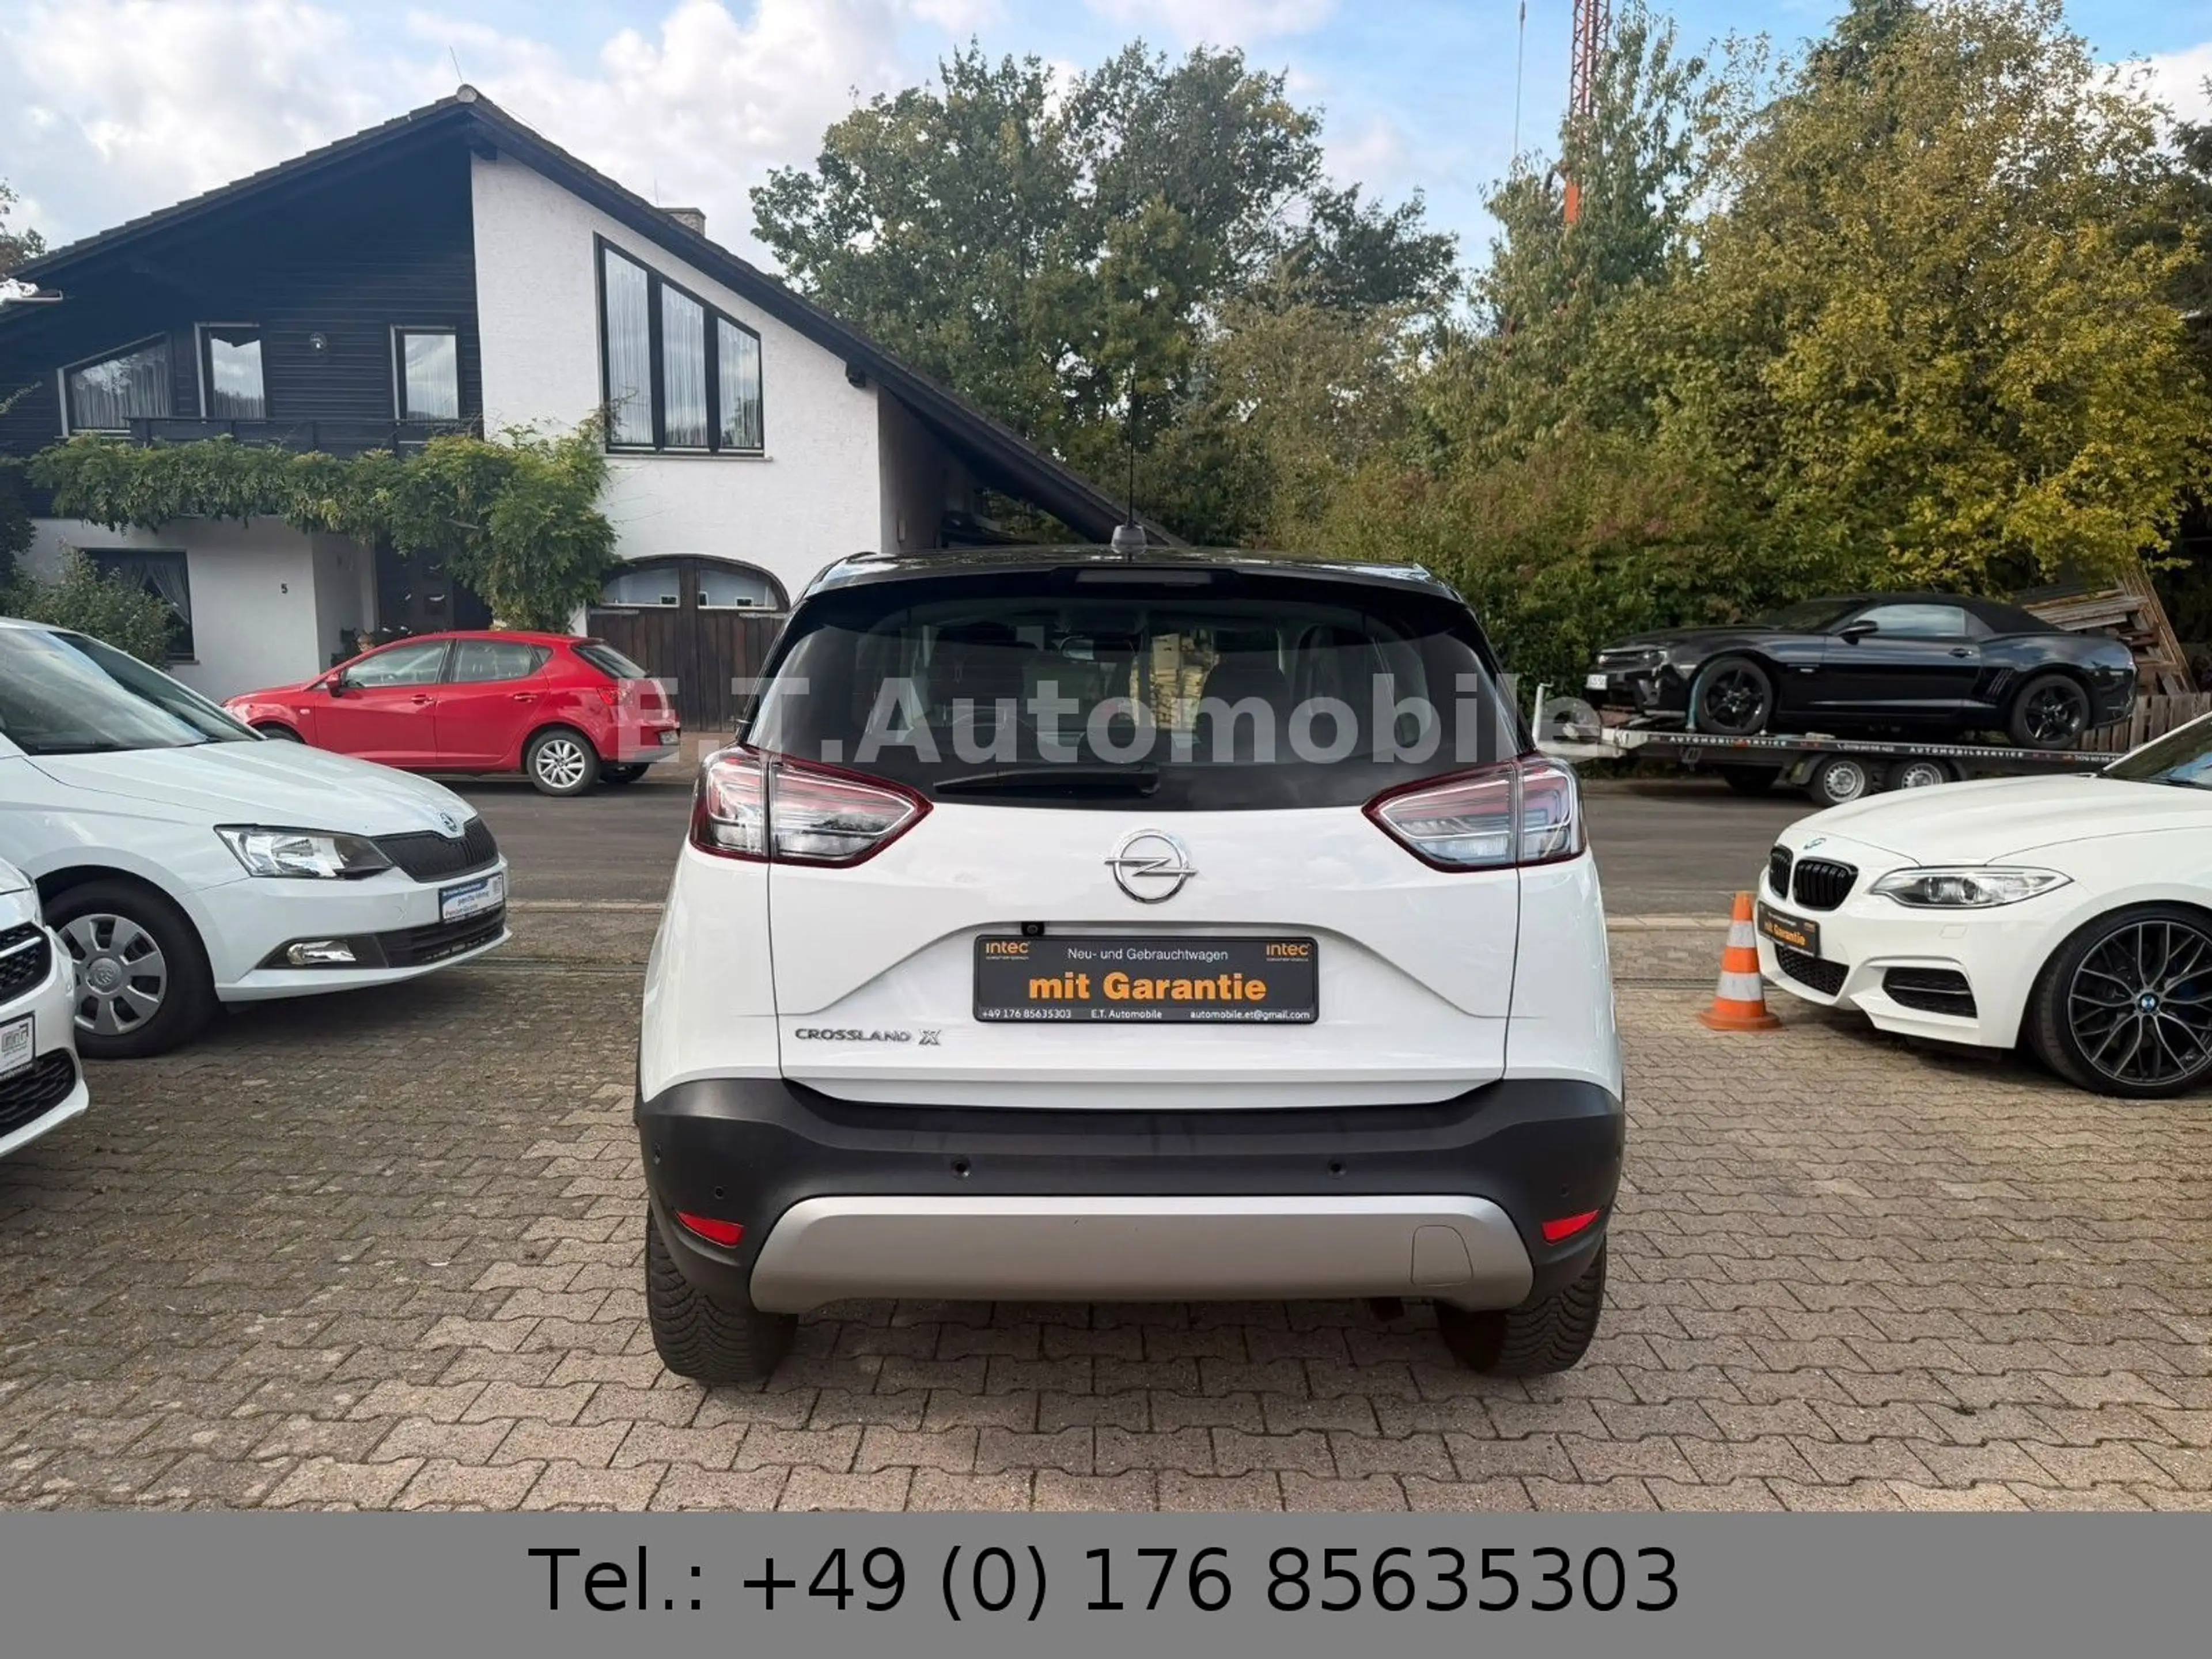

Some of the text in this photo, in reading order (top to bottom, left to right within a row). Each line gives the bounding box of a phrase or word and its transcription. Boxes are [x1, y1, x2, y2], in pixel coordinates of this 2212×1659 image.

[281, 583, 288, 594] 5
[1068, 948, 1228, 963] Neu- und Gebrauchtwagen
[1029, 972, 1267, 1001] mit Garantie
[982, 1009, 1071, 1018] +49 176 85635303
[1090, 1009, 1162, 1018] E.T. Automobile
[1190, 1010, 1310, 1021] automobile.et@gmail.com
[795, 1028, 942, 1046] CROSSLAND X
